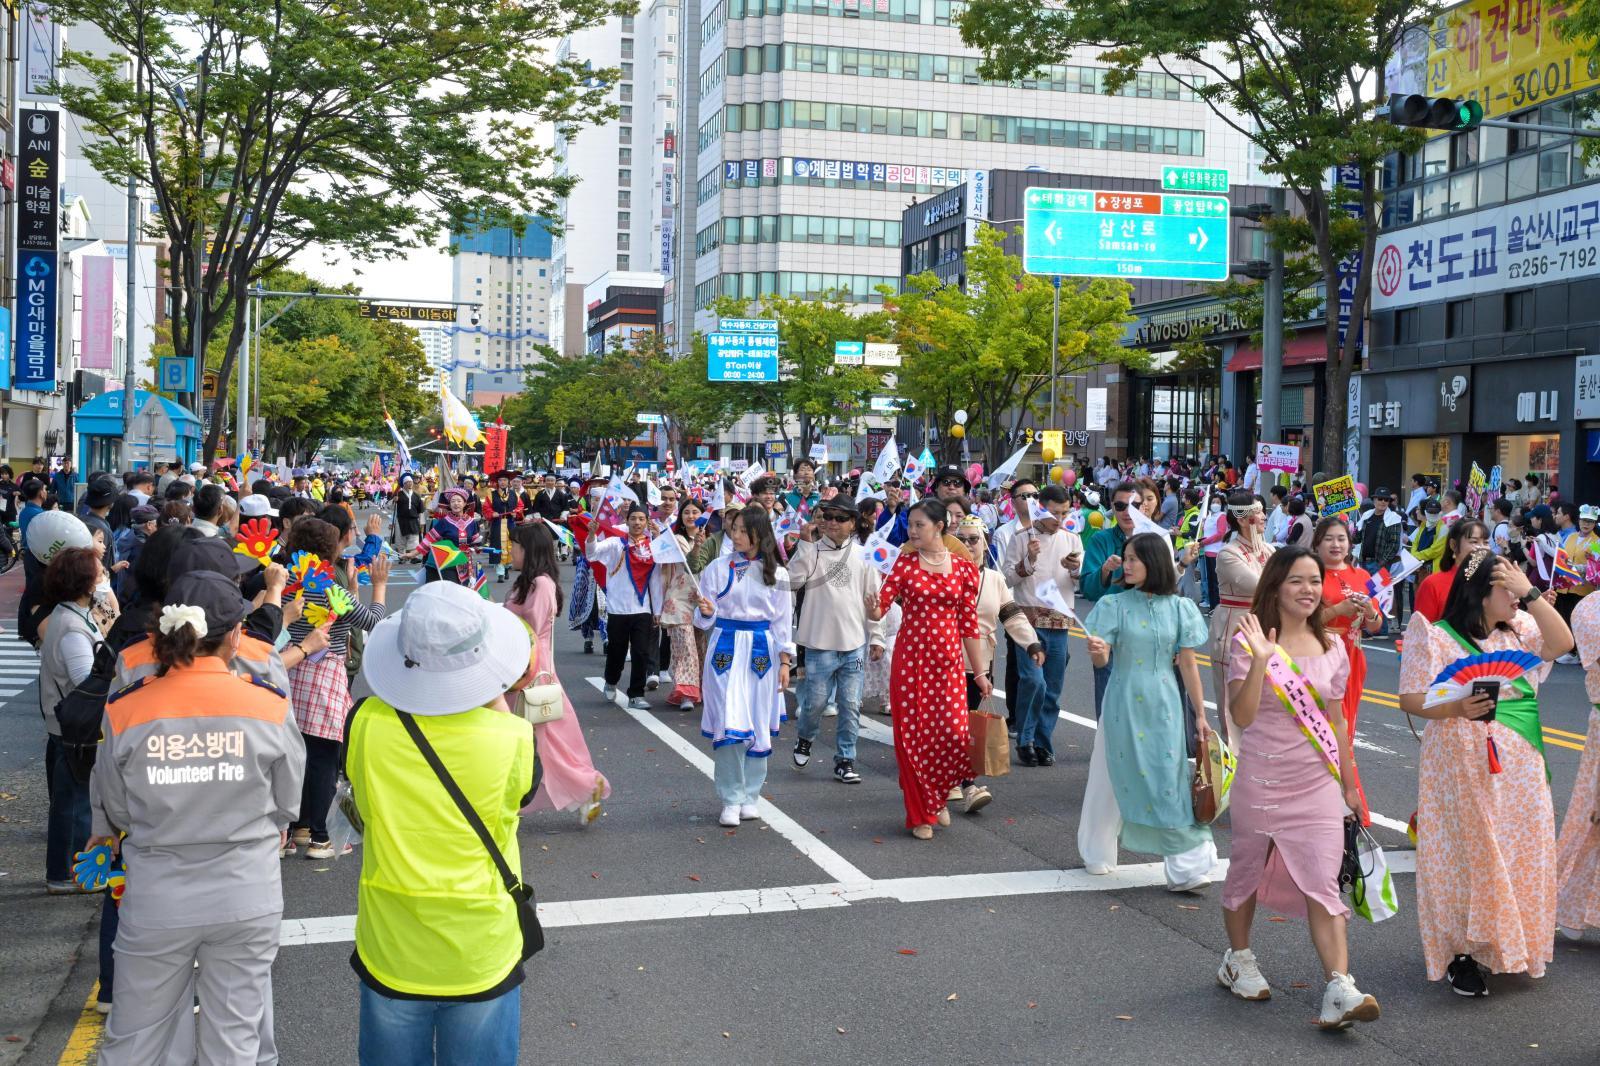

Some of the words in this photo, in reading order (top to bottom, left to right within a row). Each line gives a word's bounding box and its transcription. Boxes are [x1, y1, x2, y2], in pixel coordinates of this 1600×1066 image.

[1455, 58, 1572, 116] 1-3001
[28, 140, 50, 151] ANI
[28, 157, 49, 178] 숲
[727, 161, 758, 179] 계림
[1182, 171, 1226, 188] 석유화학공단
[26, 185, 51, 199] 미술
[25, 200, 50, 214] 학원
[1110, 196, 1144, 210] 장생포
[33, 221, 44, 229] 2F
[1056, 227, 1063, 240] E
[1098, 239, 1157, 252] Samsan-ro
[1188, 233, 1198, 245] W
[1407, 225, 1498, 292] 천도교
[1507, 200, 1600, 255] 울산시교구
[1117, 264, 1143, 274] 150m
[1522, 245, 1597, 278] 256-7192
[377, 306, 412, 320] 신속히
[26, 278, 47, 379] MG새마을금고
[169, 364, 181, 385] B
[1578, 373, 1600, 400] 울산
[1369, 401, 1401, 429] 만화
[146, 731, 244, 761] 의용소방대
[146, 764, 216, 785] Volunteer
[218, 761, 244, 781] Fire
